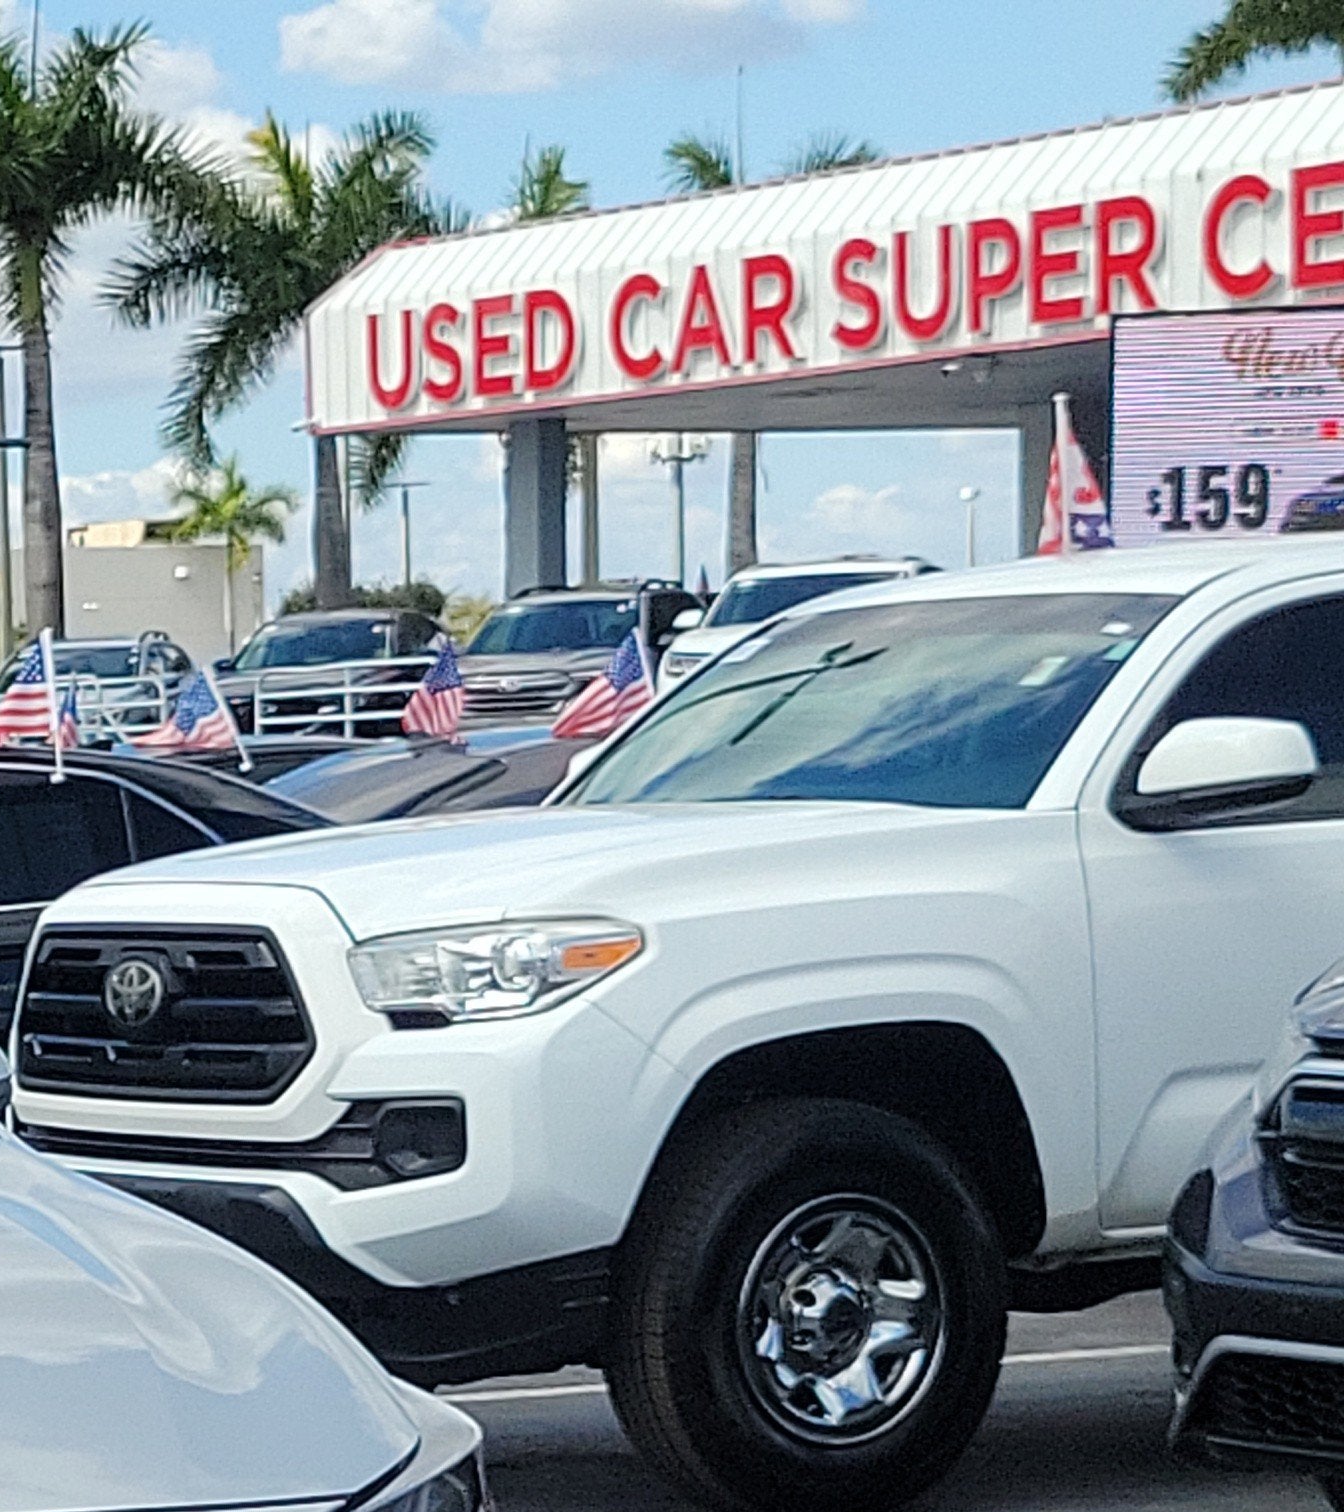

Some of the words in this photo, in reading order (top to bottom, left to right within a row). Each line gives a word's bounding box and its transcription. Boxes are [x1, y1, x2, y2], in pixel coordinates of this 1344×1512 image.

[366, 289, 575, 410] USED
[610, 253, 797, 380] CAR
[831, 195, 1159, 350] SUPER
[1202, 160, 1344, 299] CE
[1146, 464, 1270, 531] $159
